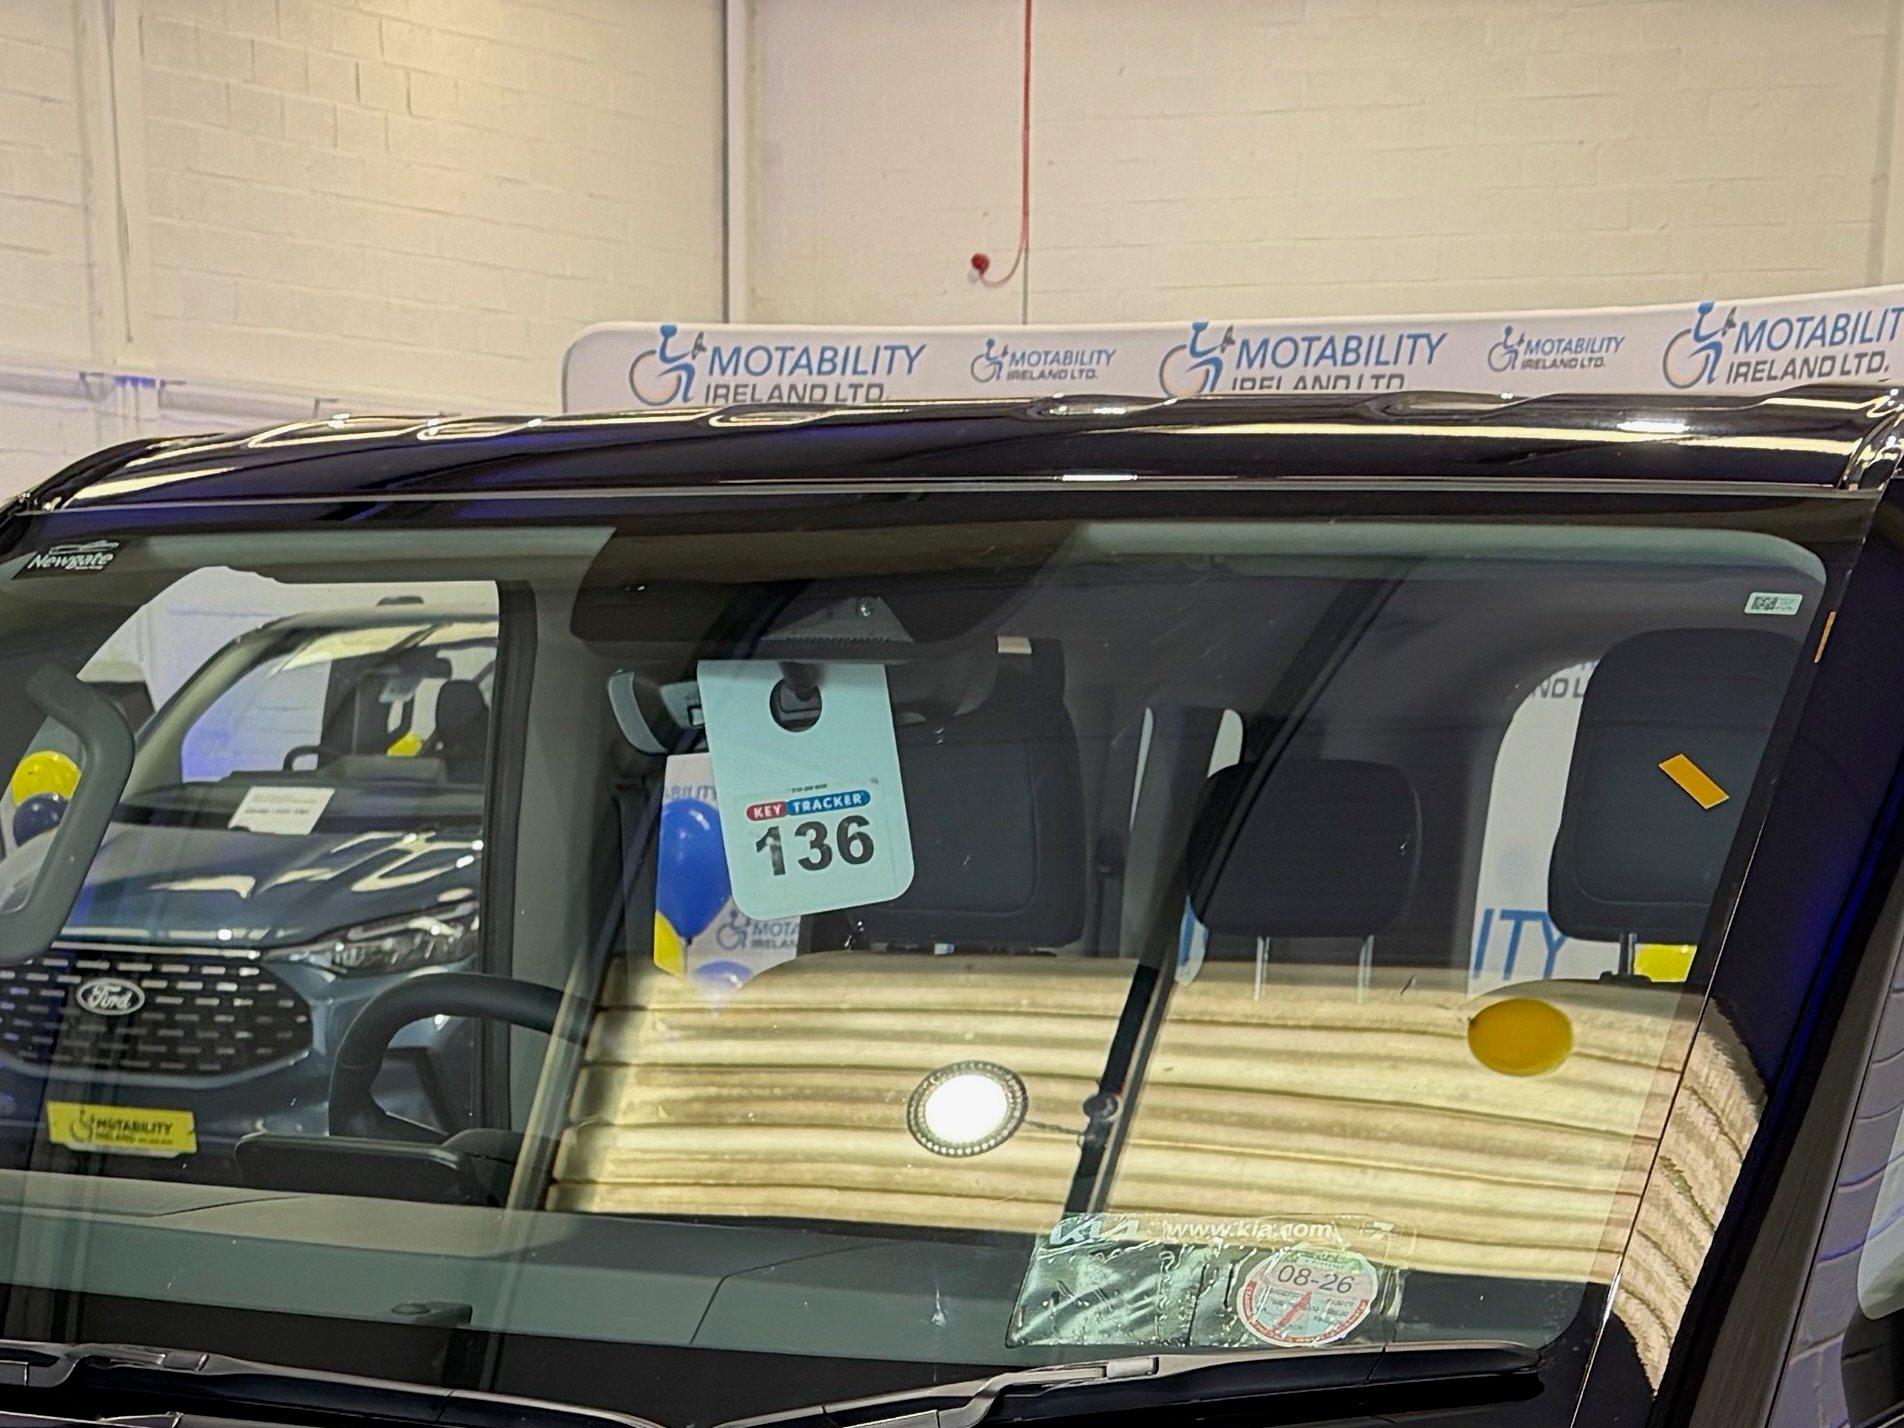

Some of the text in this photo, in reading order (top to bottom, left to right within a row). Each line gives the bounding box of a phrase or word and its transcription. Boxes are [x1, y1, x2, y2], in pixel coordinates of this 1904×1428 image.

[1008, 348, 1117, 368] MOTABILITY
[1235, 332, 1449, 370] MOTABILITY
[1523, 335, 1626, 356] MOTABILITY
[707, 343, 928, 377] MOTABILITY
[1521, 357, 1578, 370] IRELAND
[1725, 354, 1837, 385] IRELAND
[1006, 368, 1069, 381] IRELAND
[703, 382, 829, 405] IRELAND
[26, 551, 115, 570] Newgate
[753, 792, 862, 820] KEY TRACKER
[754, 814, 876, 877] 136
[86, 983, 133, 1011] Ford
[1166, 1219, 1334, 1239] www.kia.com
[1277, 1264, 1356, 1294] 08-26
